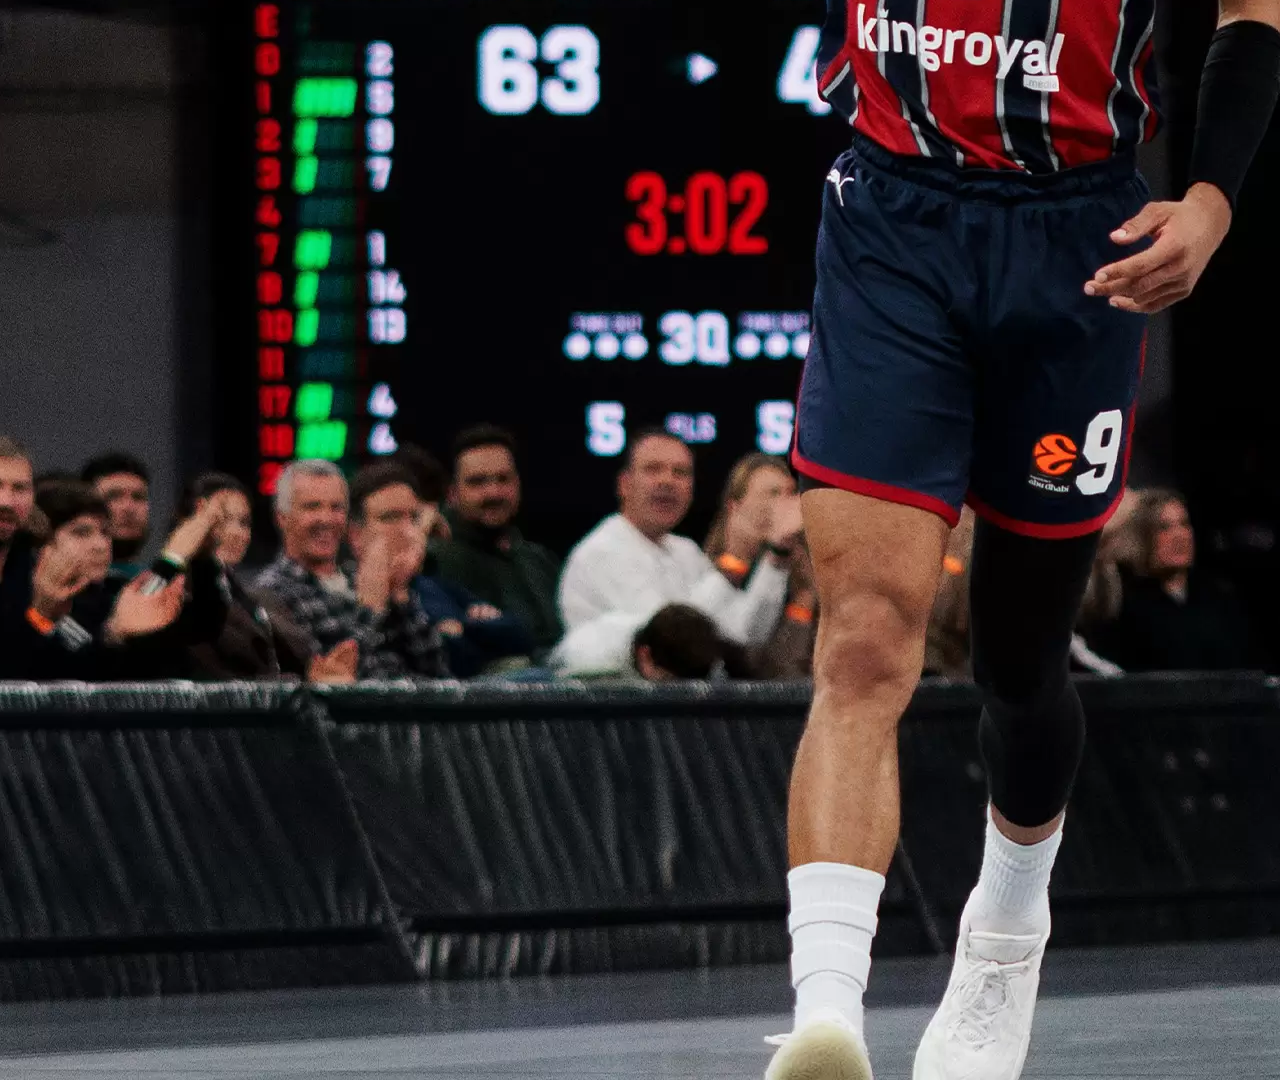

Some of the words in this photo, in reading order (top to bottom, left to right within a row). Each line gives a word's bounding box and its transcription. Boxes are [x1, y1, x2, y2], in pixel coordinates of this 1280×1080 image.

[477, 25, 601, 115] 63
[857, 3, 1065, 79] kingroyal
[367, 155, 393, 190] 7
[626, 171, 769, 255] 3:02
[1075, 409, 1123, 495] 9
